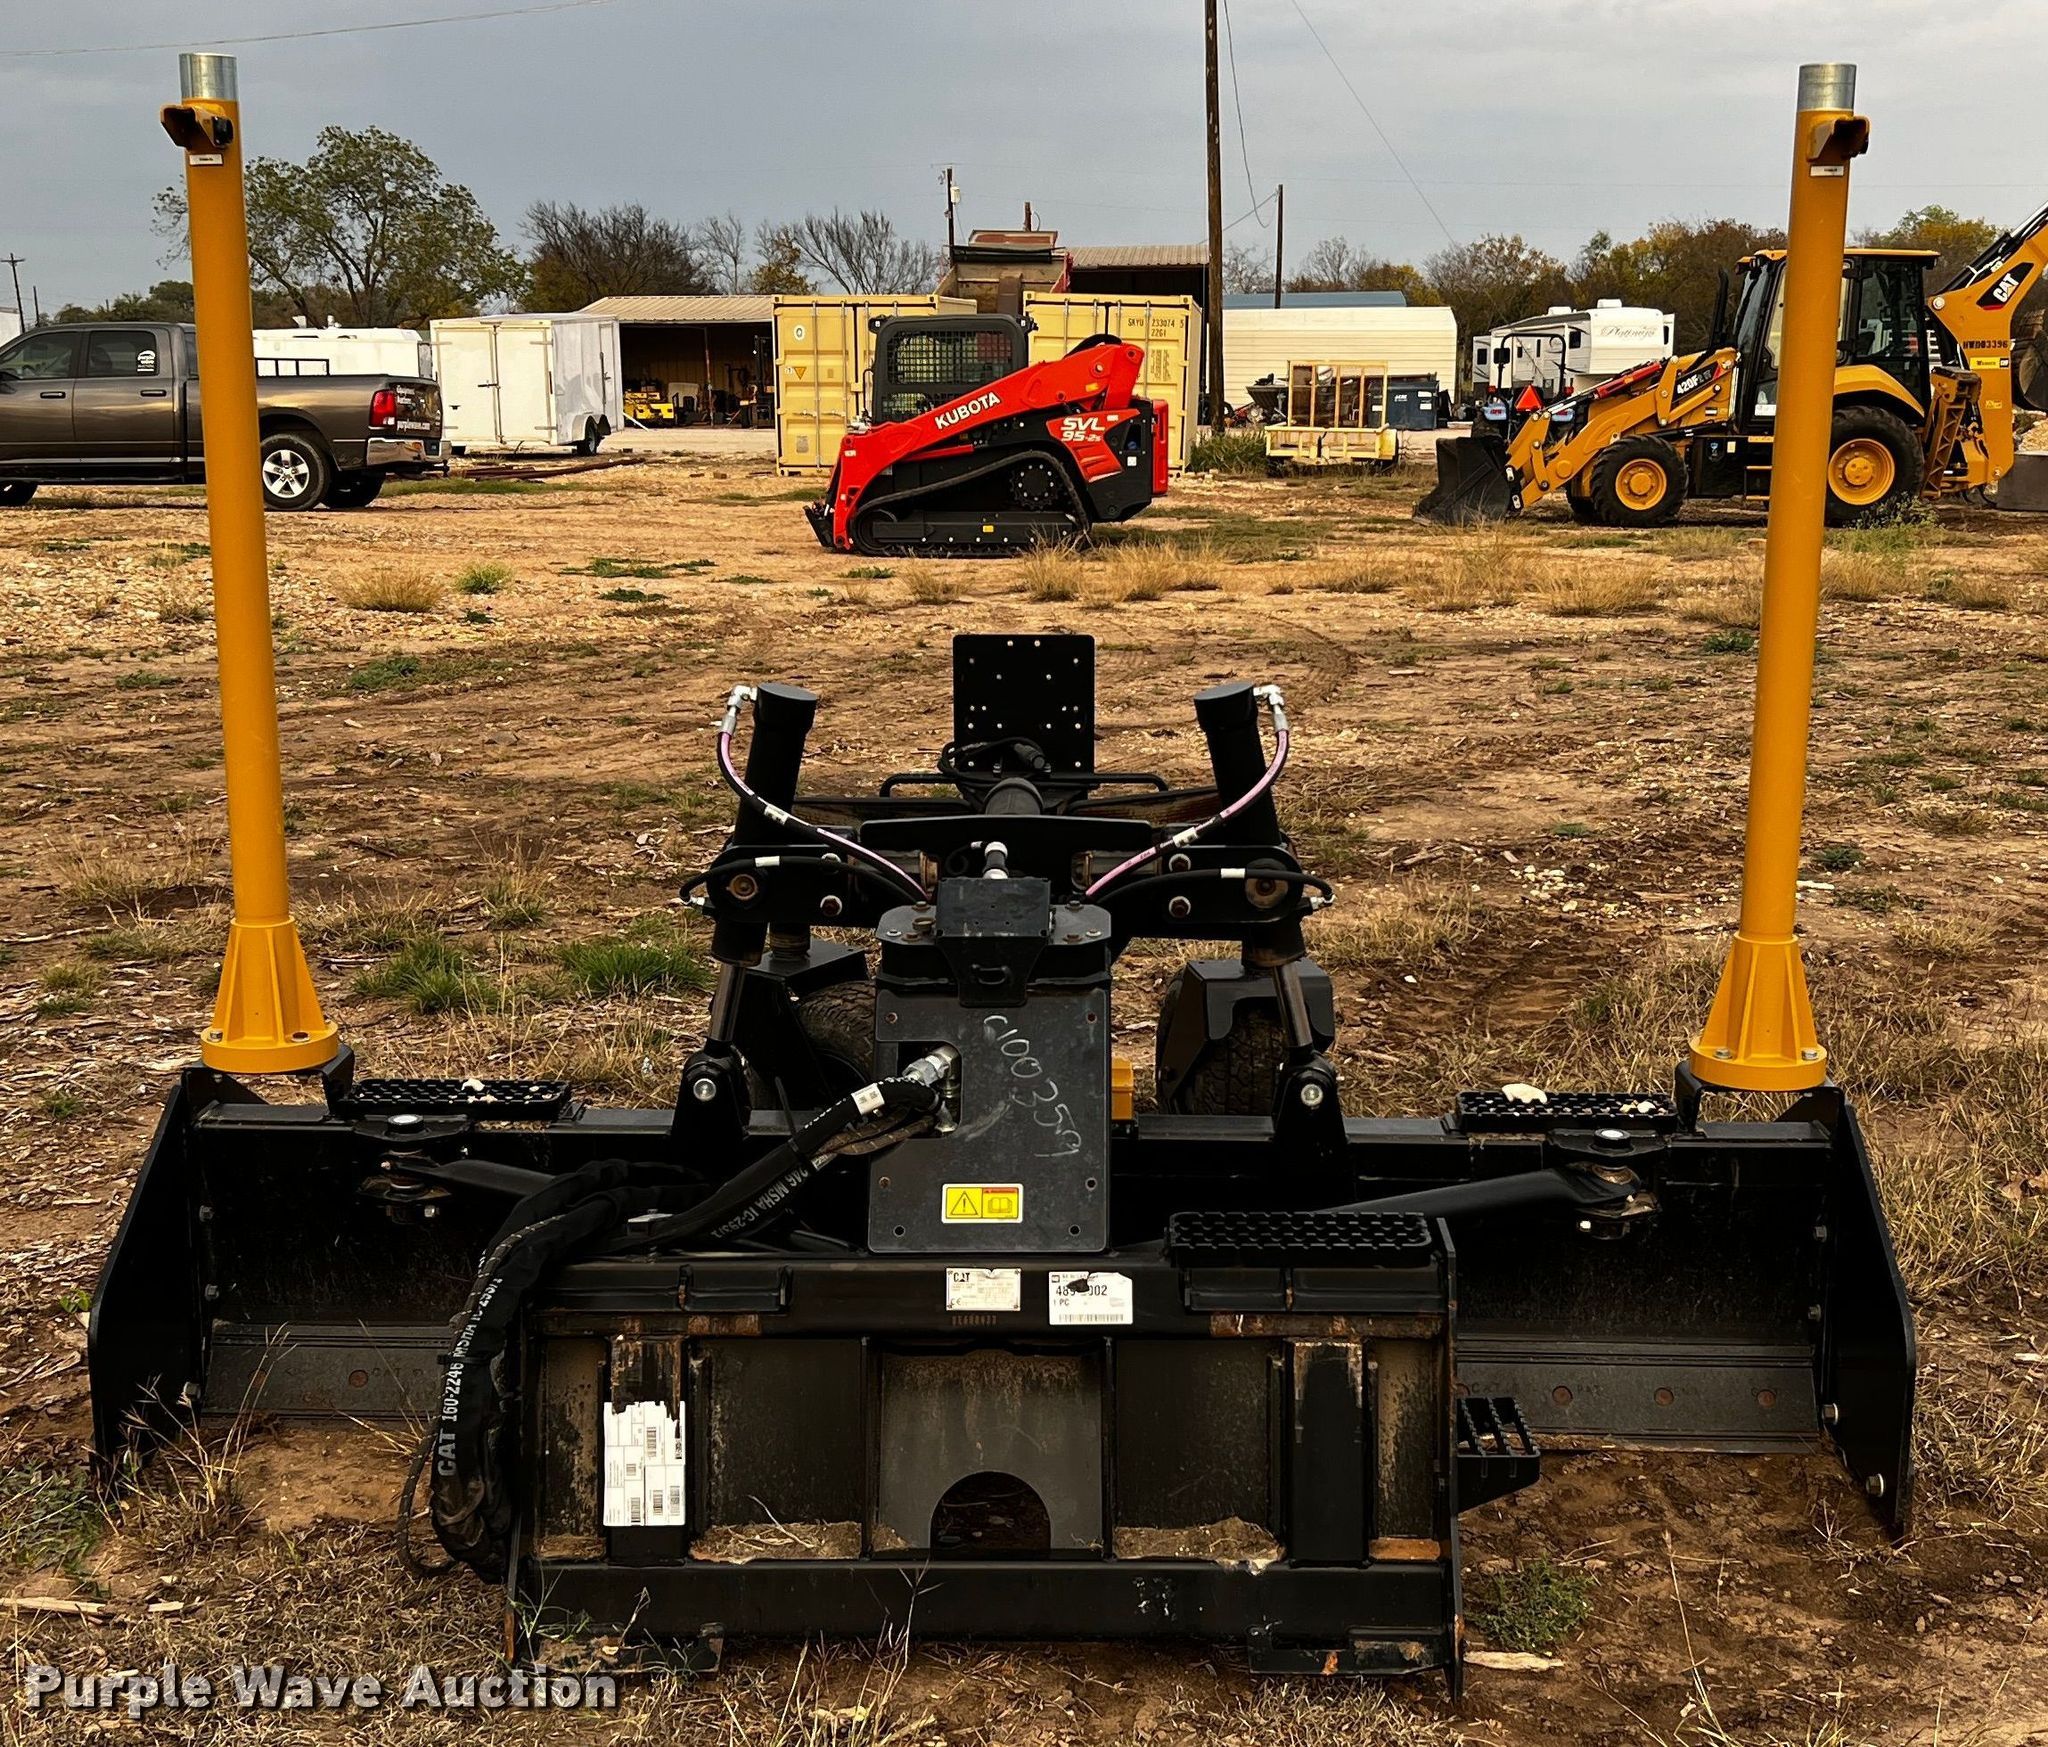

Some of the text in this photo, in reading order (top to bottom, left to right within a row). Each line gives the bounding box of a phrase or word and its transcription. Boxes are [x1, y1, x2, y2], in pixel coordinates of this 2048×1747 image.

[1993, 273, 2019, 303] CAT
[934, 392, 1001, 430] KUBOTA
[1060, 416, 1106, 431] SVL
[754, 1180, 790, 1210] MSHA
[953, 1272, 971, 1283] CAT
[1059, 1299, 1070, 1307] PC
[441, 1362, 465, 1423] 160-2246
[437, 1427, 457, 1477] CAT
